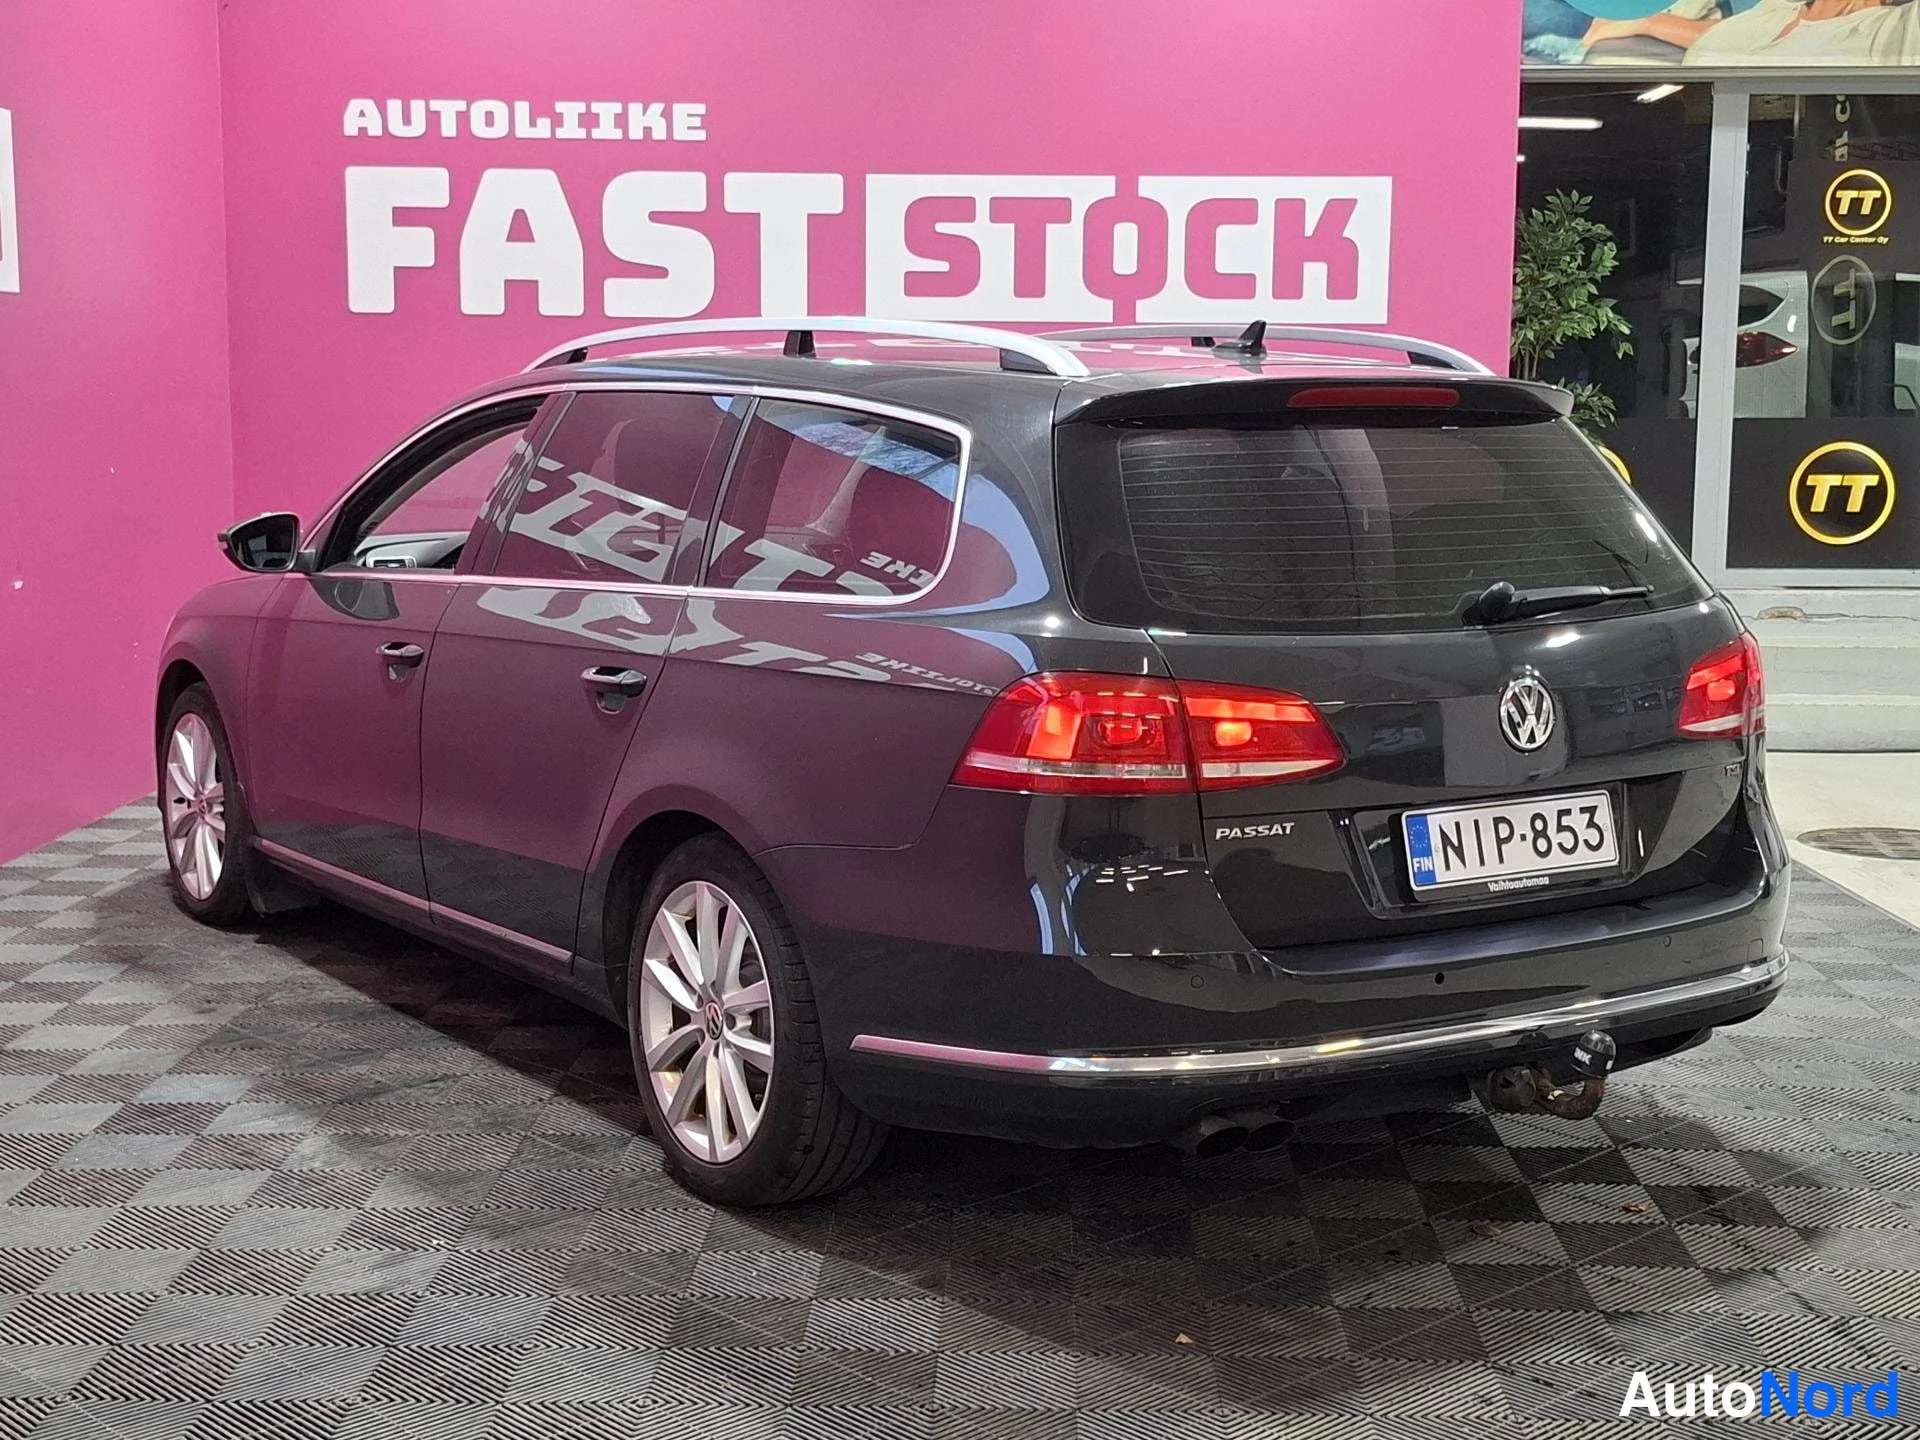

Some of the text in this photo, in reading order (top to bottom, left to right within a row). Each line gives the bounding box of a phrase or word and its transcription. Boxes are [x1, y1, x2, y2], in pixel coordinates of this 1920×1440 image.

[343, 98, 708, 141] AUTOLIIKE
[1835, 190, 1882, 215] TT
[345, 166, 1359, 318] FAST STOCK
[1806, 474, 1880, 513] TT
[1215, 822, 1295, 840] PASSAT
[1438, 804, 1605, 872] NIP-853
[1413, 856, 1433, 873] FIN
[1487, 876, 1550, 892] Vaihtoautomaa
